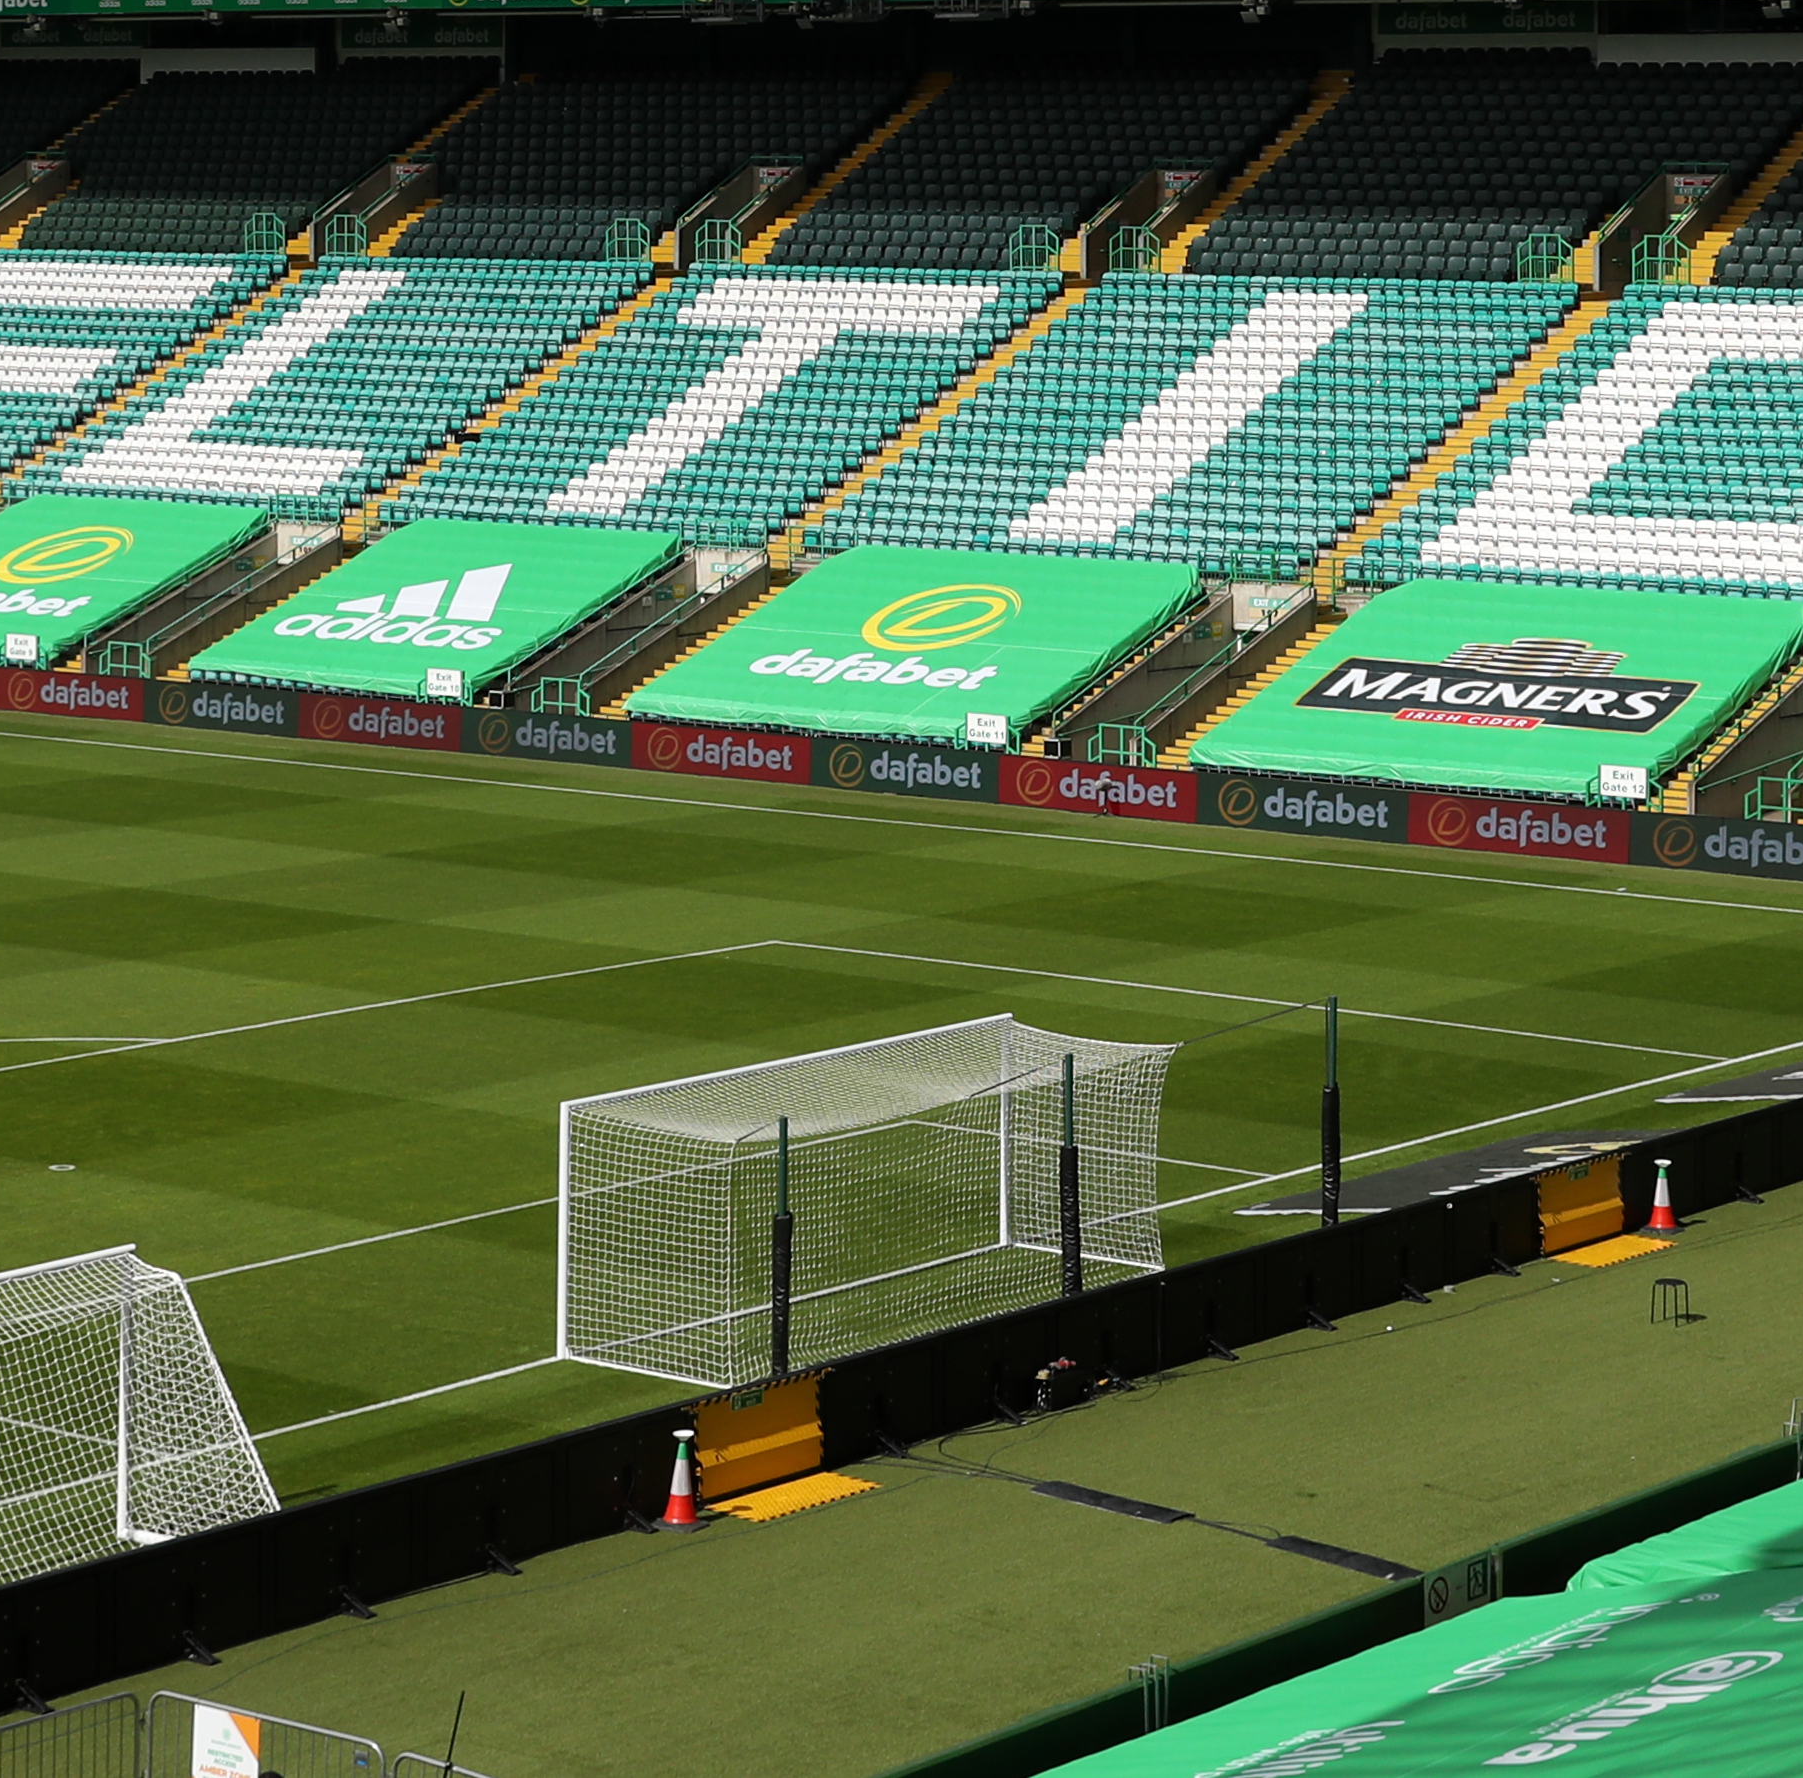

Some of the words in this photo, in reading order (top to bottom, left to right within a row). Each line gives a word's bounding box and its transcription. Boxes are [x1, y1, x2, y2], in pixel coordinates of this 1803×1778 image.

[273, 609, 503, 651] adidas
[427, 682, 447, 692] Gate
[449, 684, 460, 694] 10
[436, 672, 453, 682] Exit
[749, 648, 1000, 692] dafabet
[41, 678, 129, 713] dafabet
[192, 688, 285, 725] dafabet
[1322, 668, 1672, 720] MAGNERS
[348, 703, 445, 740] dafabet
[515, 719, 617, 756] dafabet
[968, 728, 991, 740] Gate
[994, 730, 1005, 741] 11
[977, 717, 997, 728] Exit
[1405, 709, 1462, 724] IRISH
[1467, 713, 1530, 729] CIDER
[686, 733, 793, 772] dafabet
[869, 749, 982, 789] dafabet
[1602, 781, 1629, 793] Gate
[1632, 784, 1645, 795] 12
[1612, 770, 1635, 781] Exit
[1263, 786, 1389, 829] dafabet
[1475, 807, 1607, 849] dafabet
[199, 1763, 229, 1777] AMBER
